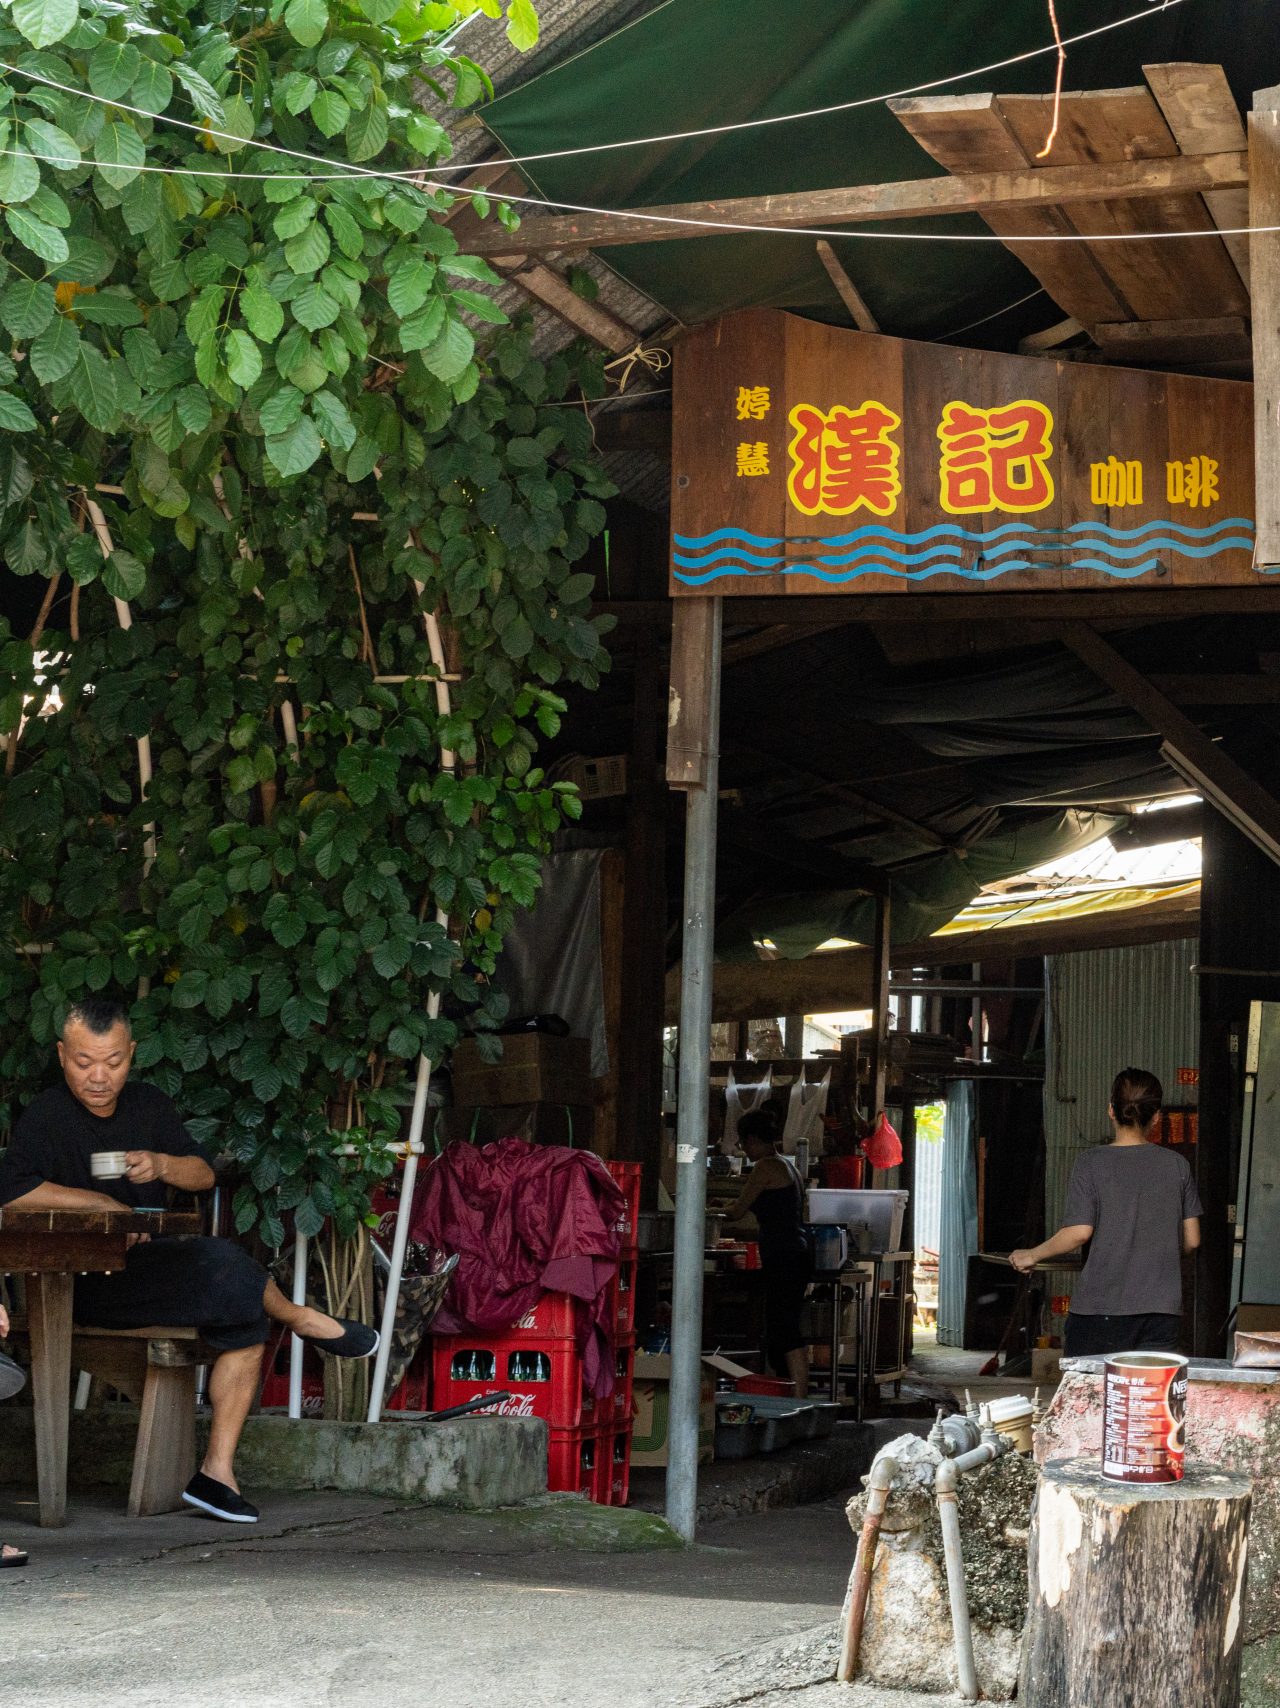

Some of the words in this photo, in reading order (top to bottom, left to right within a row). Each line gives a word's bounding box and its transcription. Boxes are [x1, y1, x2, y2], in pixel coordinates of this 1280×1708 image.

[736, 386, 770, 476] 婷慧
[788, 400, 1055, 516] 漢記
[1090, 456, 1220, 508] 咖啡
